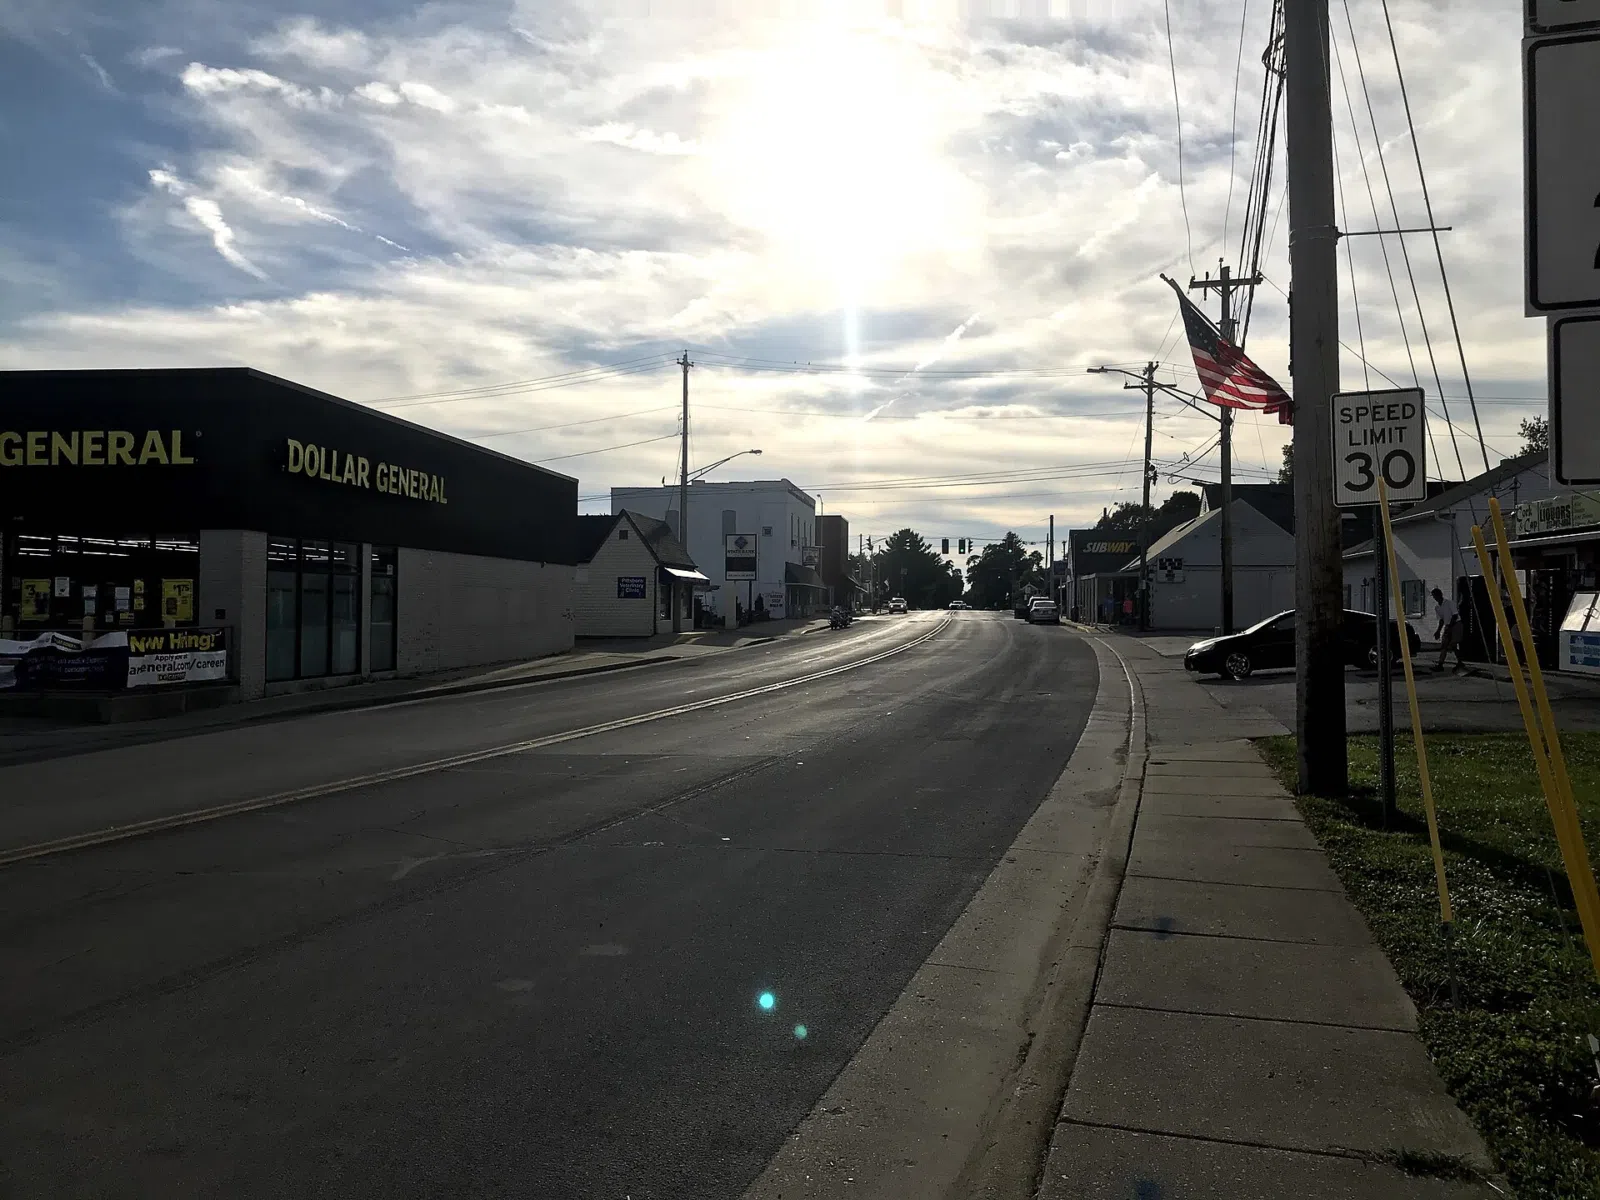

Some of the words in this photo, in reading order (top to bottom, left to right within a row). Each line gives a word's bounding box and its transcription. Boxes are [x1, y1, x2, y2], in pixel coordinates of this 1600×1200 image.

[1340, 403, 1415, 423] SPEED
[1349, 427, 1407, 446] LIMIT
[0, 429, 194, 467] GENERAL
[287, 438, 370, 489] DOLLAR
[376, 461, 448, 504] GENERAL
[1344, 449, 1415, 491] 30
[1540, 504, 1571, 522] LIQUORS
[1082, 541, 1133, 553] SUBWAY
[130, 635, 165, 652] Nw
